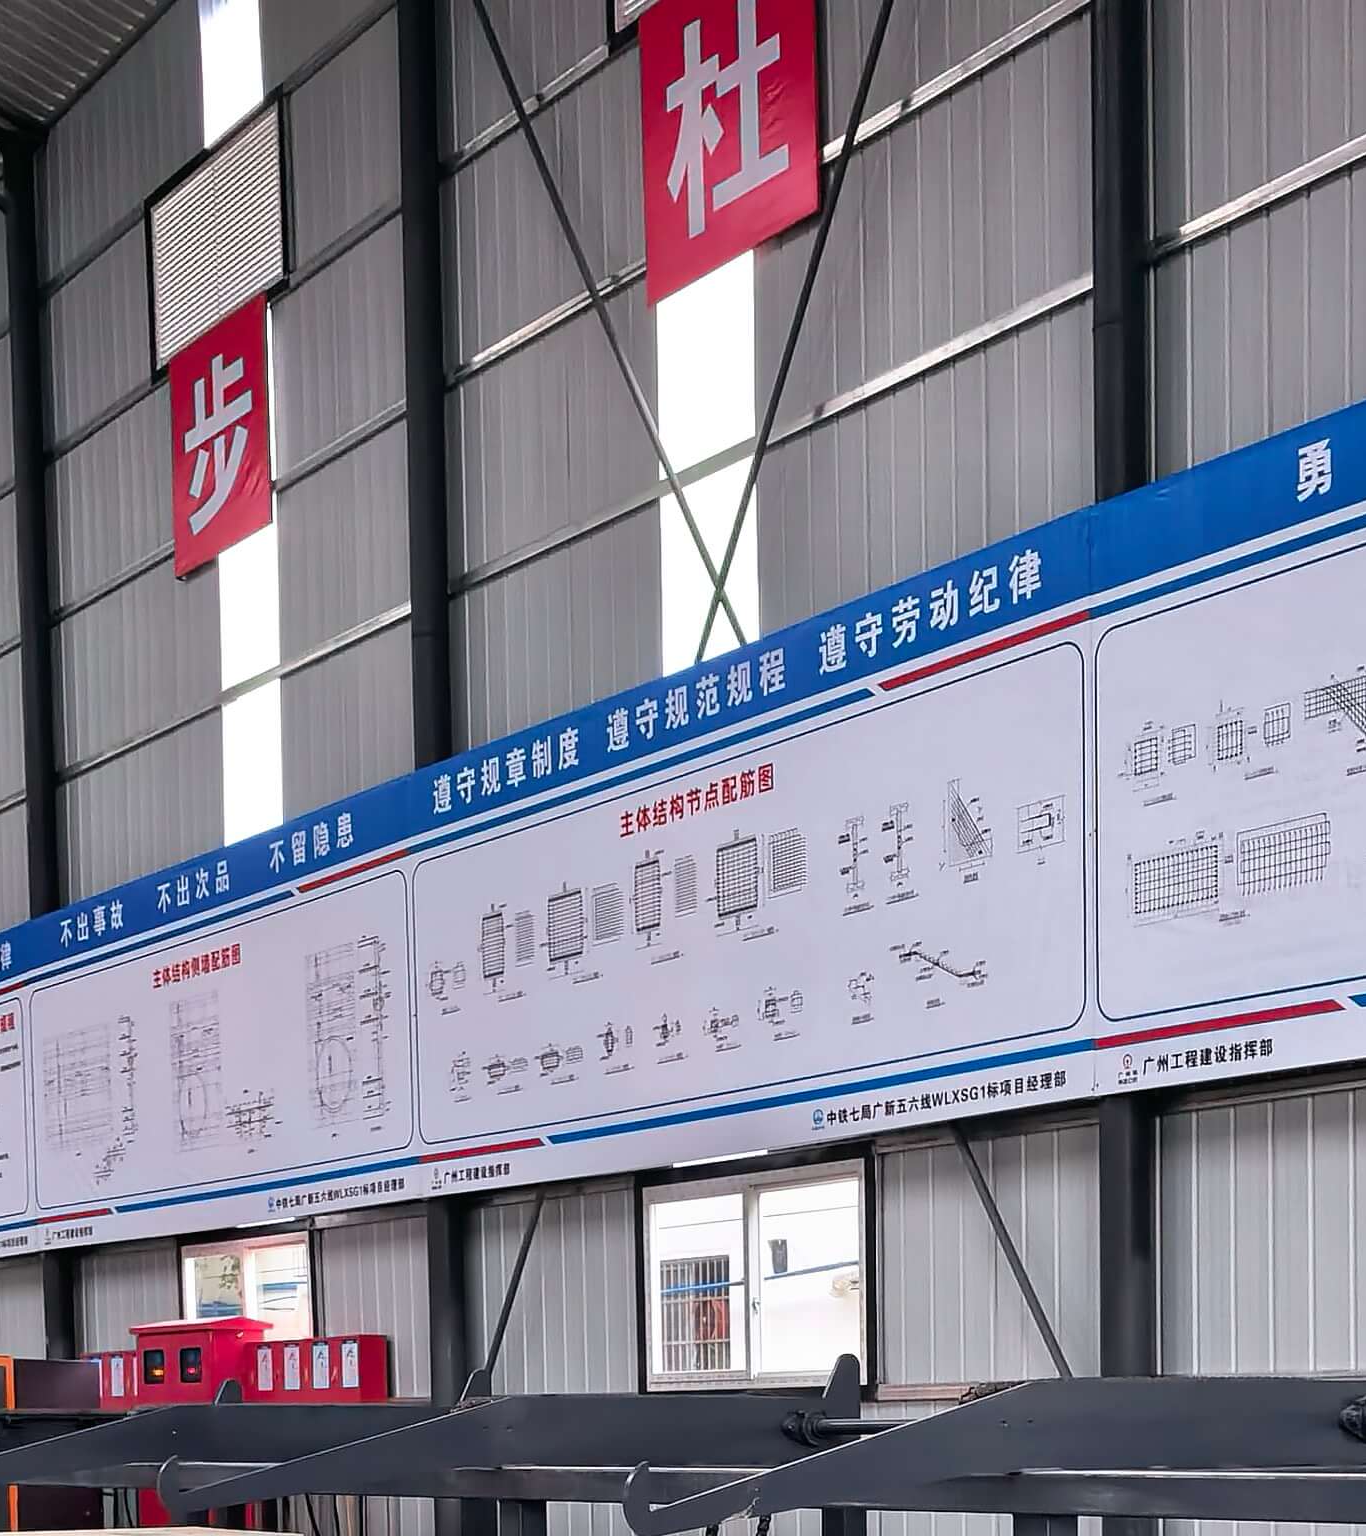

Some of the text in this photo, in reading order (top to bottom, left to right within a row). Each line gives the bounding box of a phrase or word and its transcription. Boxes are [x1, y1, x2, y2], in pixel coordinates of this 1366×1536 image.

[666, 0, 789, 238] 杜
[184, 355, 253, 536] 步
[432, 549, 1043, 815] 遵守规章制度 遵守规范规程 遵守劳动纪律
[619, 762, 775, 839] 主体结构节点配筋图
[60, 812, 354, 948] 不出事故 不出次品 不留隐患
[826, 1070, 1067, 1125] 中铁七局广新五六线WLXSG1标项目经理部
[1143, 1038, 1273, 1075] 广州工程建设指挥部
